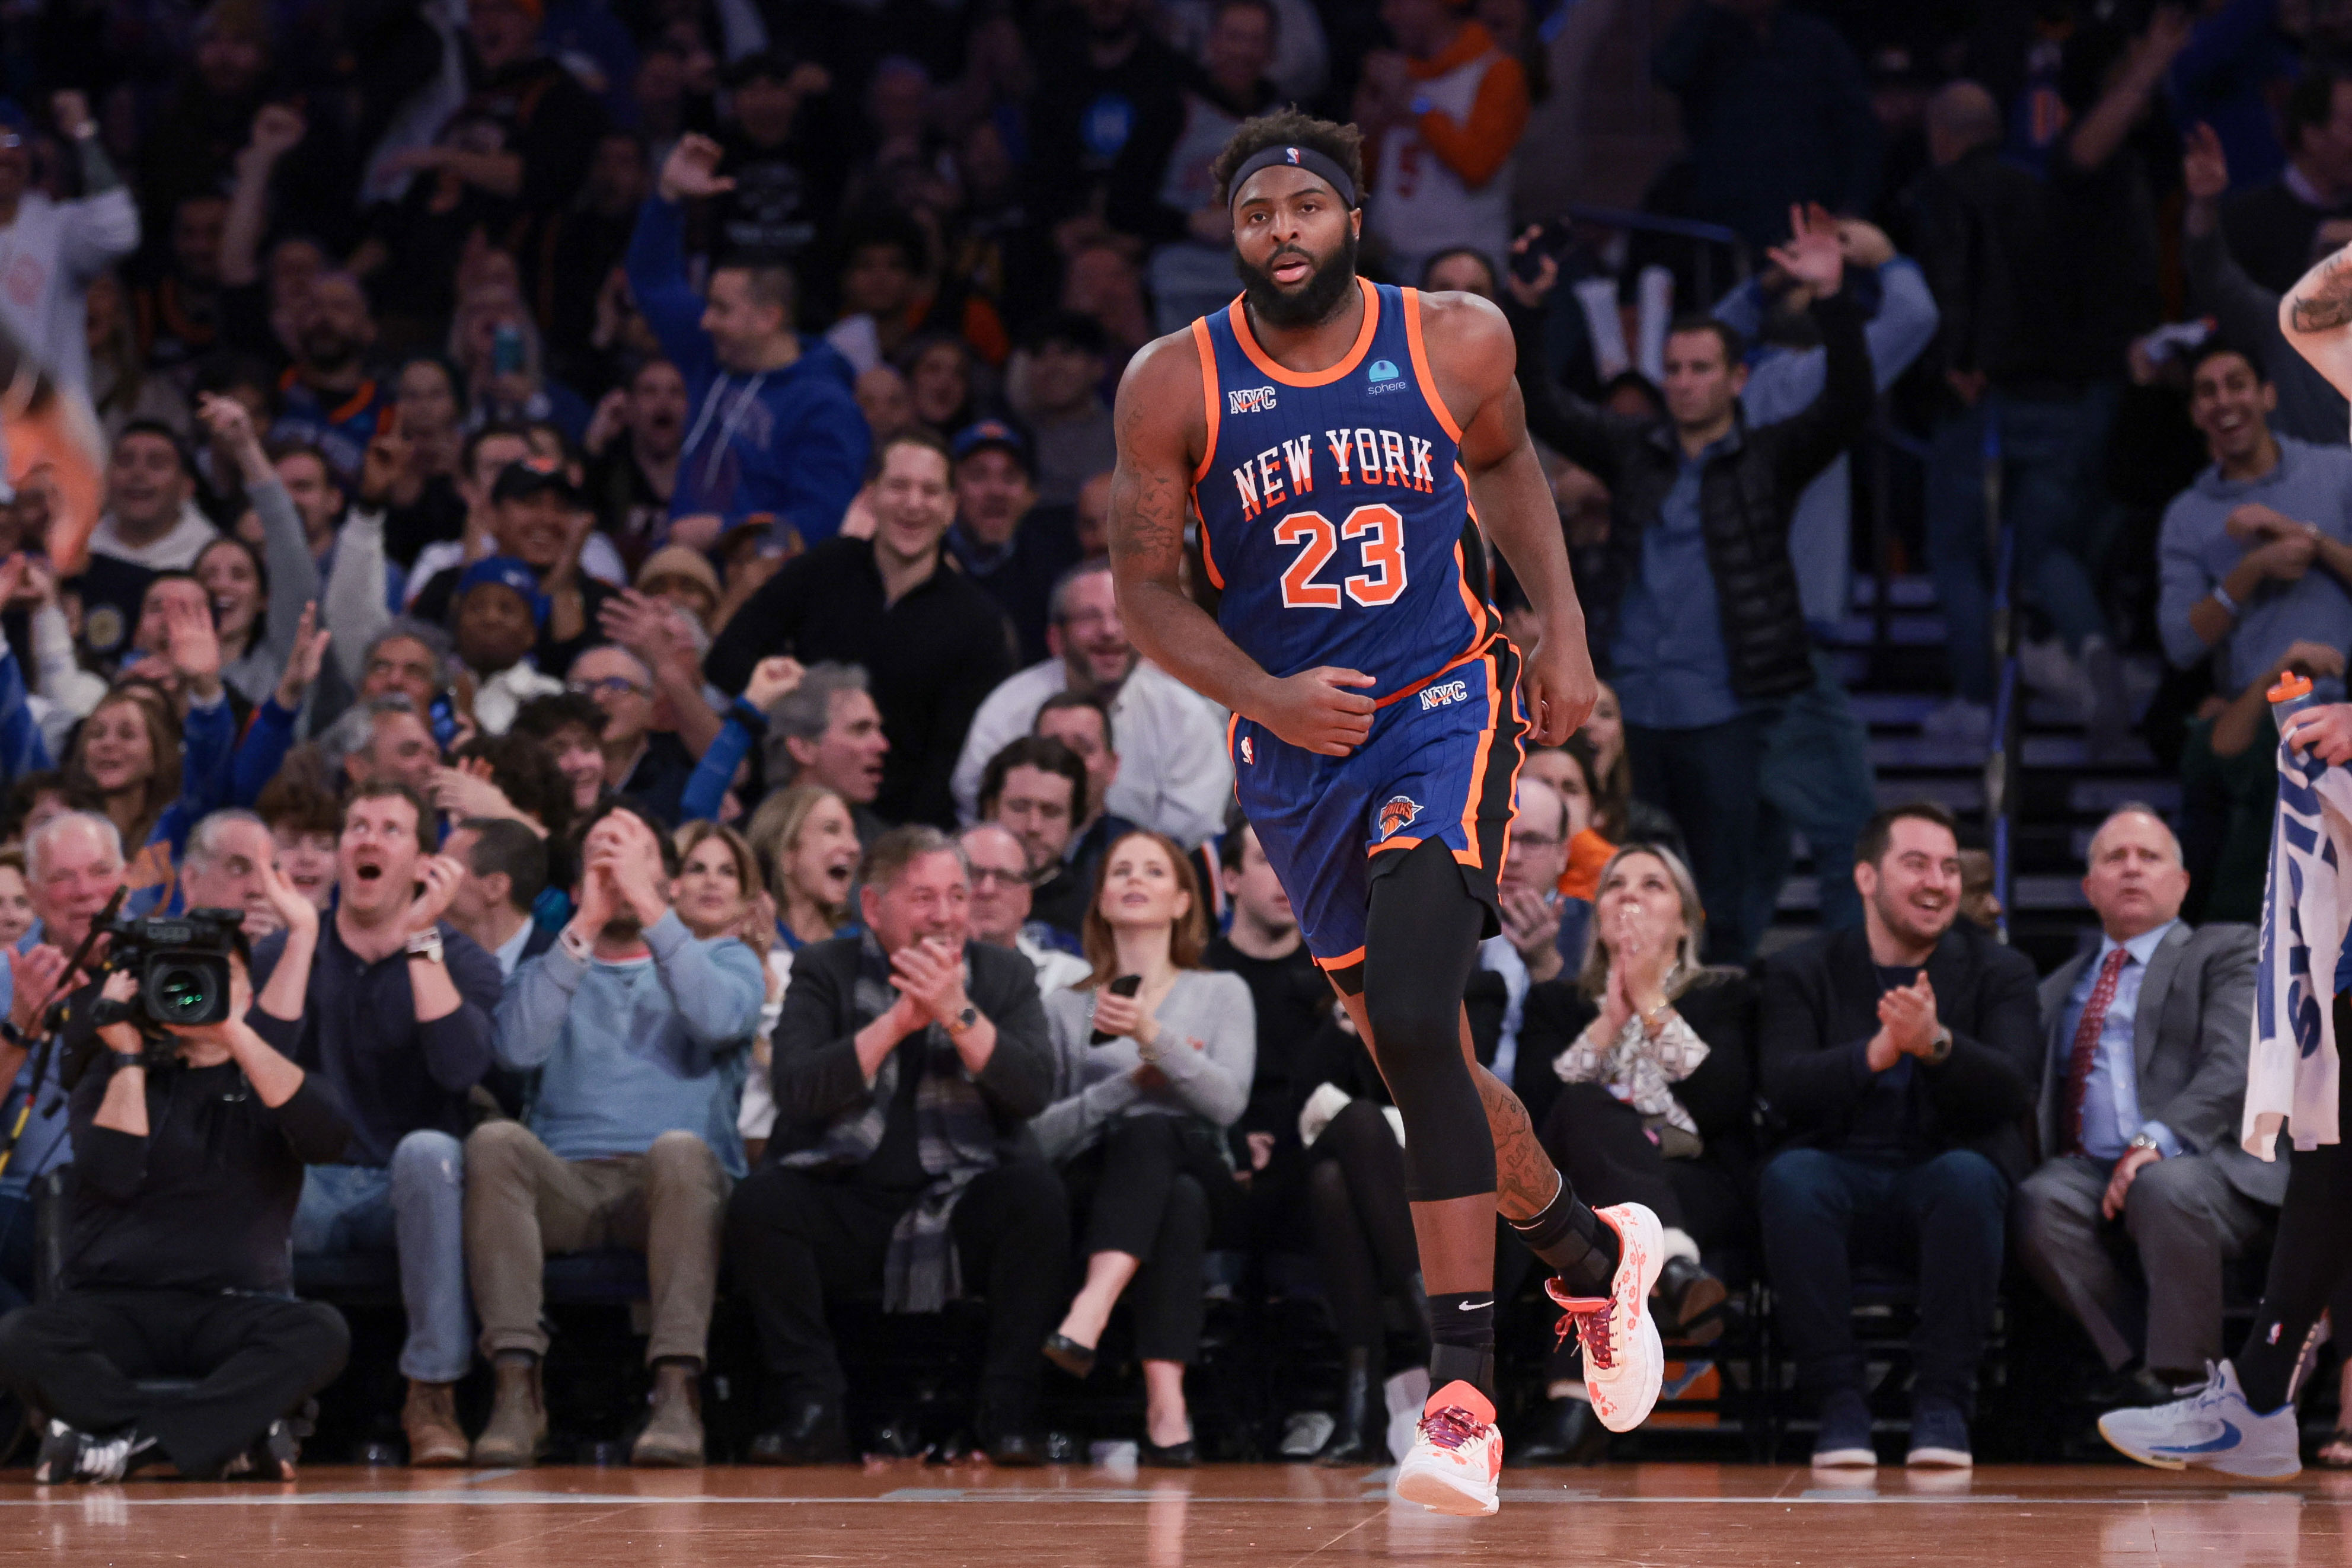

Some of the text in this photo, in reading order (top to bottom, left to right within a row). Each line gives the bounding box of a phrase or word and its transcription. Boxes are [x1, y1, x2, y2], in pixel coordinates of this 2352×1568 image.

[1228, 386, 1276, 414] NYC
[1368, 381, 1406, 395] sphere
[1233, 429, 1434, 521] NEW YORK
[1274, 503, 1408, 609] 23
[1419, 681, 1467, 710] NYC
